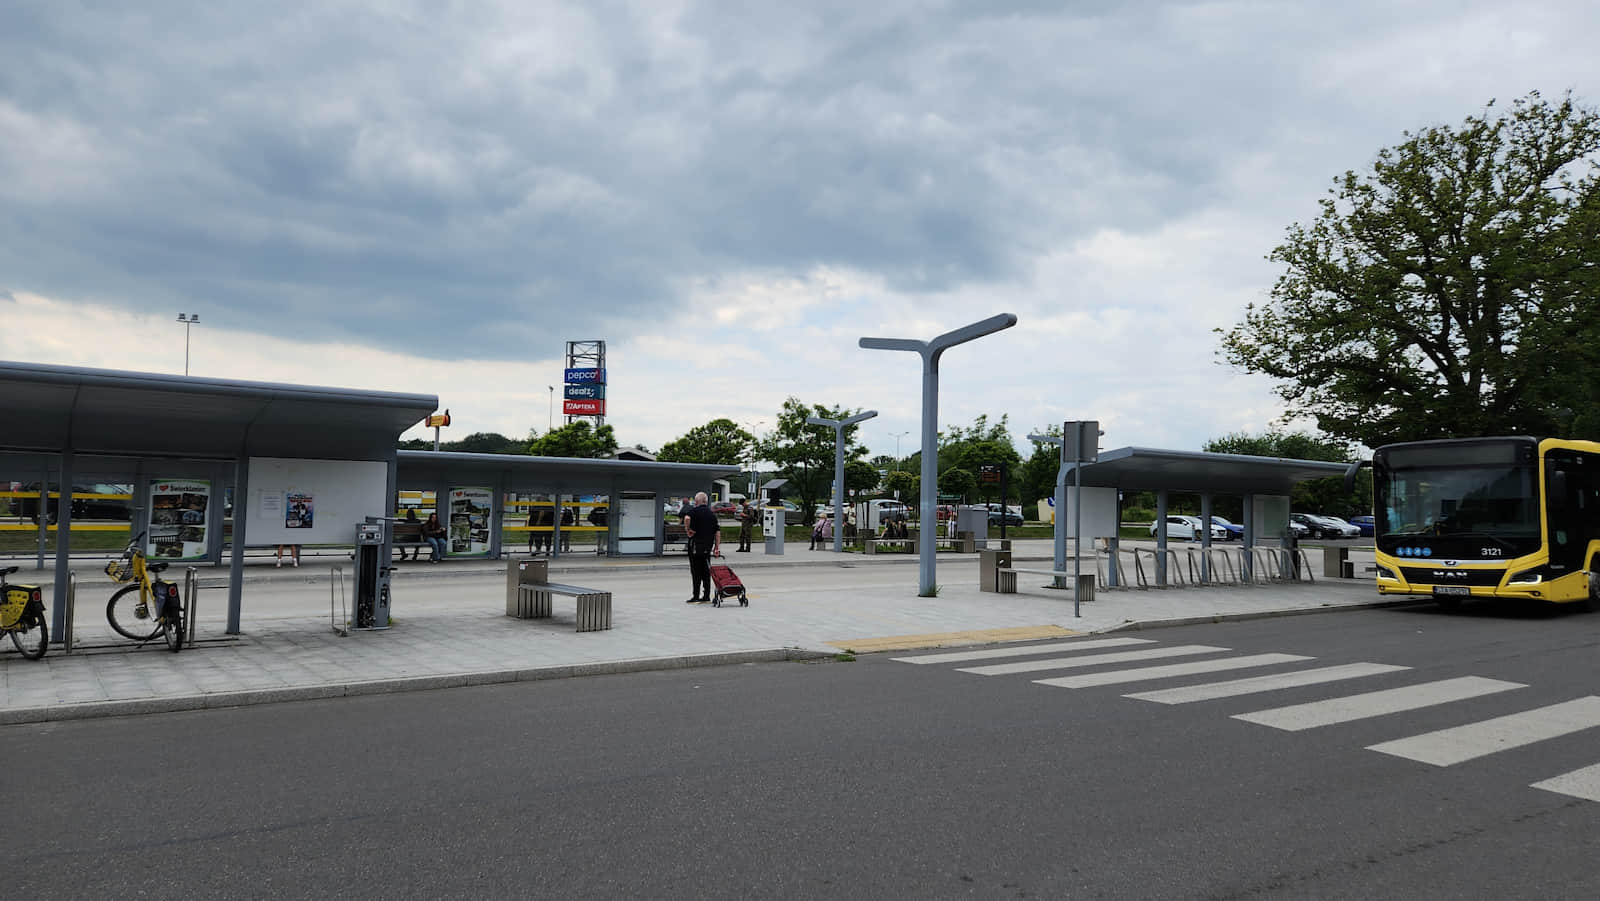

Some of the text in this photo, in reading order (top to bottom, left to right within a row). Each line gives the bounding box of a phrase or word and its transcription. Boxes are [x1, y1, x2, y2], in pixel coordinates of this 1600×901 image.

[568, 371, 596, 381] pepco
[1481, 548, 1502, 556] 3121
[1433, 571, 1468, 579] MAN
